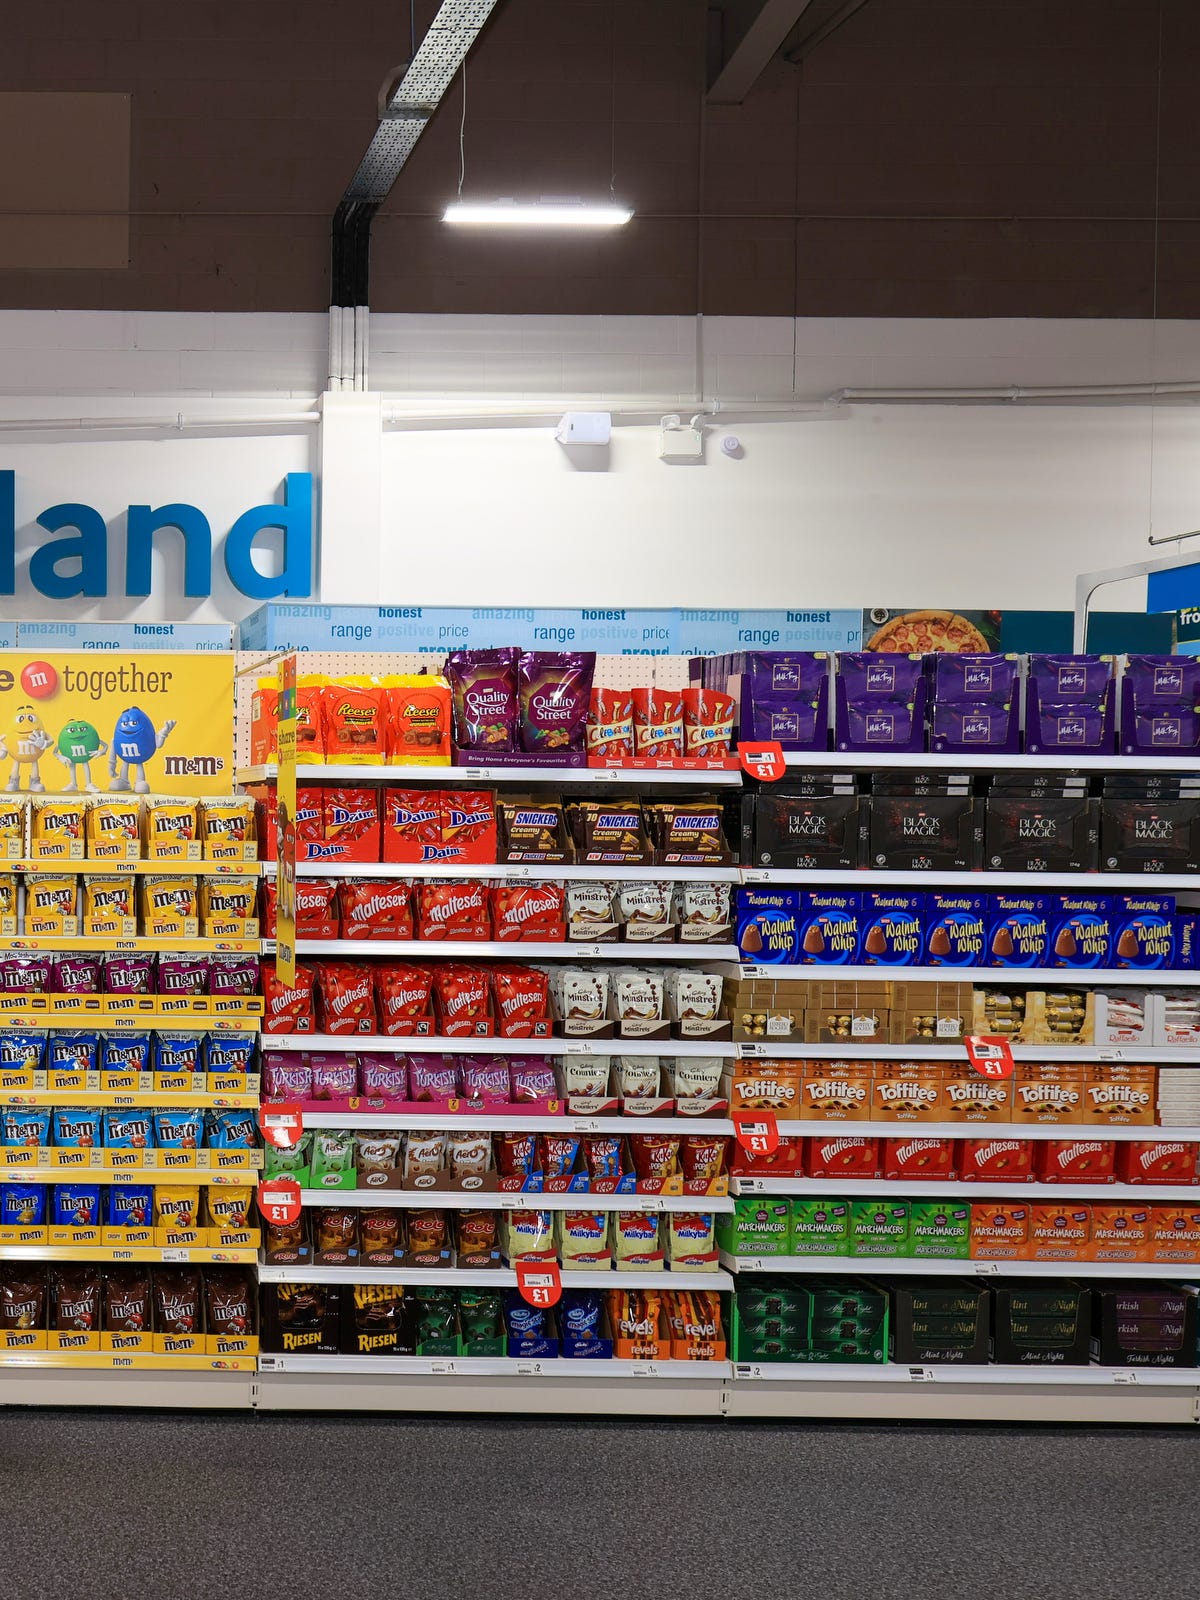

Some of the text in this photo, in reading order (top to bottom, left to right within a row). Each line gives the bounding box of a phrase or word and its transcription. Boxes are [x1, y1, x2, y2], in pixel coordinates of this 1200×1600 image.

[379, 607, 534, 622] honest amazing
[582, 609, 831, 622] honest honest
[19, 623, 174, 635] amazing honest
[331, 623, 575, 642] range positive price range
[581, 626, 669, 641] positive price
[739, 628, 842, 644] range positive
[83, 640, 223, 650] range price
[30, 670, 47, 688] m
[64, 663, 171, 699] together
[467, 691, 510, 705] Quality
[533, 696, 576, 711] Quality
[337, 704, 377, 718] Reese's
[403, 705, 440, 718] Reese's
[471, 703, 506, 716] Street
[536, 709, 572, 721] Street
[279, 729, 295, 743] share
[71, 745, 87, 757] m
[122, 742, 140, 757] m
[166, 756, 224, 775] m&m's
[394, 808, 437, 825] Daim
[450, 810, 491, 826] Daim
[516, 813, 558, 826] SNICKERS
[673, 816, 719, 829] SNICKERS
[789, 816, 826, 824] BLACK
[903, 817, 940, 826] BLACK
[1020, 819, 1056, 828] BLACK
[511, 827, 540, 835] Creamy
[670, 831, 699, 839] Creamy
[789, 825, 826, 835] MAGIC
[903, 826, 940, 836] MAGIC
[1020, 828, 1056, 838] MAGIC
[306, 842, 345, 859] Daim
[422, 845, 460, 859] Daim
[522, 852, 545, 860] SNICKERS
[430, 894, 483, 922] Maltesers
[505, 897, 560, 923] Maltesers
[762, 916, 796, 936] Walnut
[886, 918, 920, 938] Walnut
[1138, 921, 1172, 941] Walnut
[769, 934, 793, 951] Whip
[893, 935, 918, 953] Whip
[1145, 938, 1170, 956] Whip
[1109, 1034, 1140, 1042] Raffaello
[313, 1067, 356, 1087] TURKISH
[415, 1067, 455, 1087] TURKISH
[735, 1080, 796, 1099] Toffifee
[877, 1082, 938, 1102] Toffifee
[1018, 1084, 1079, 1104] Toffifee
[1088, 1085, 1150, 1105] Toffifee
[451, 1099, 457, 1107] 7
[974, 1141, 1020, 1167] Maltesers
[272, 1206, 288, 1220] £1
[624, 1230, 655, 1239] Milkybar
[678, 1230, 708, 1239] Milkybar
[738, 1222, 785, 1233] MATCHMAKERS
[855, 1224, 904, 1235] MATCHMAKERS
[974, 1227, 1024, 1237] MATCHMAKERS
[1096, 1229, 1144, 1239] MATCHMAKERS
[283, 1332, 322, 1350] RIESEN
[358, 1333, 397, 1351] RIESEN
[631, 1345, 658, 1355] revels
[687, 1346, 714, 1356] revels
[921, 1351, 964, 1361] Mint Nights
[1151, 1355, 1174, 1364] Nights
